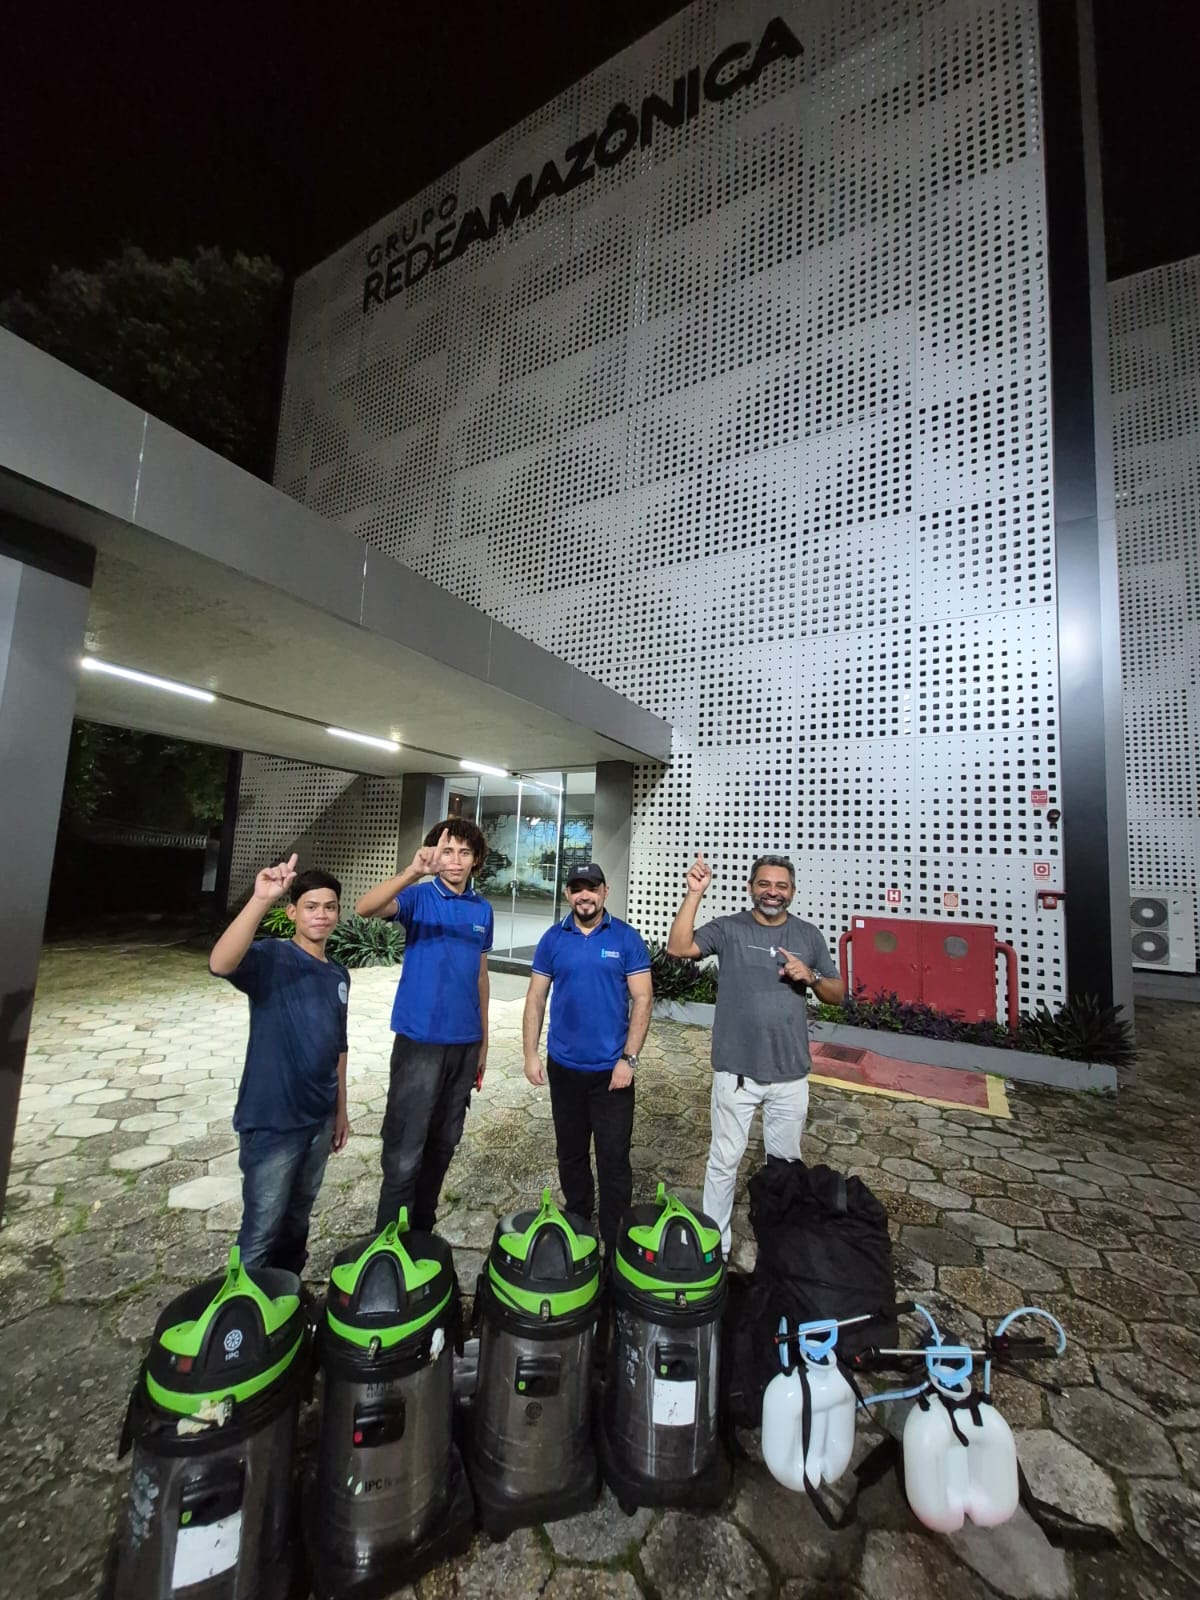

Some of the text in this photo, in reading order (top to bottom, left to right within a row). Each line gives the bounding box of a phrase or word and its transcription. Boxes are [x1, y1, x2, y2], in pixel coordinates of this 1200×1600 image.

[367, 193, 458, 268] GRUPO
[889, 890, 900, 902] H
[225, 1350, 240, 1361] IPC
[364, 1478, 383, 1493] IPC
